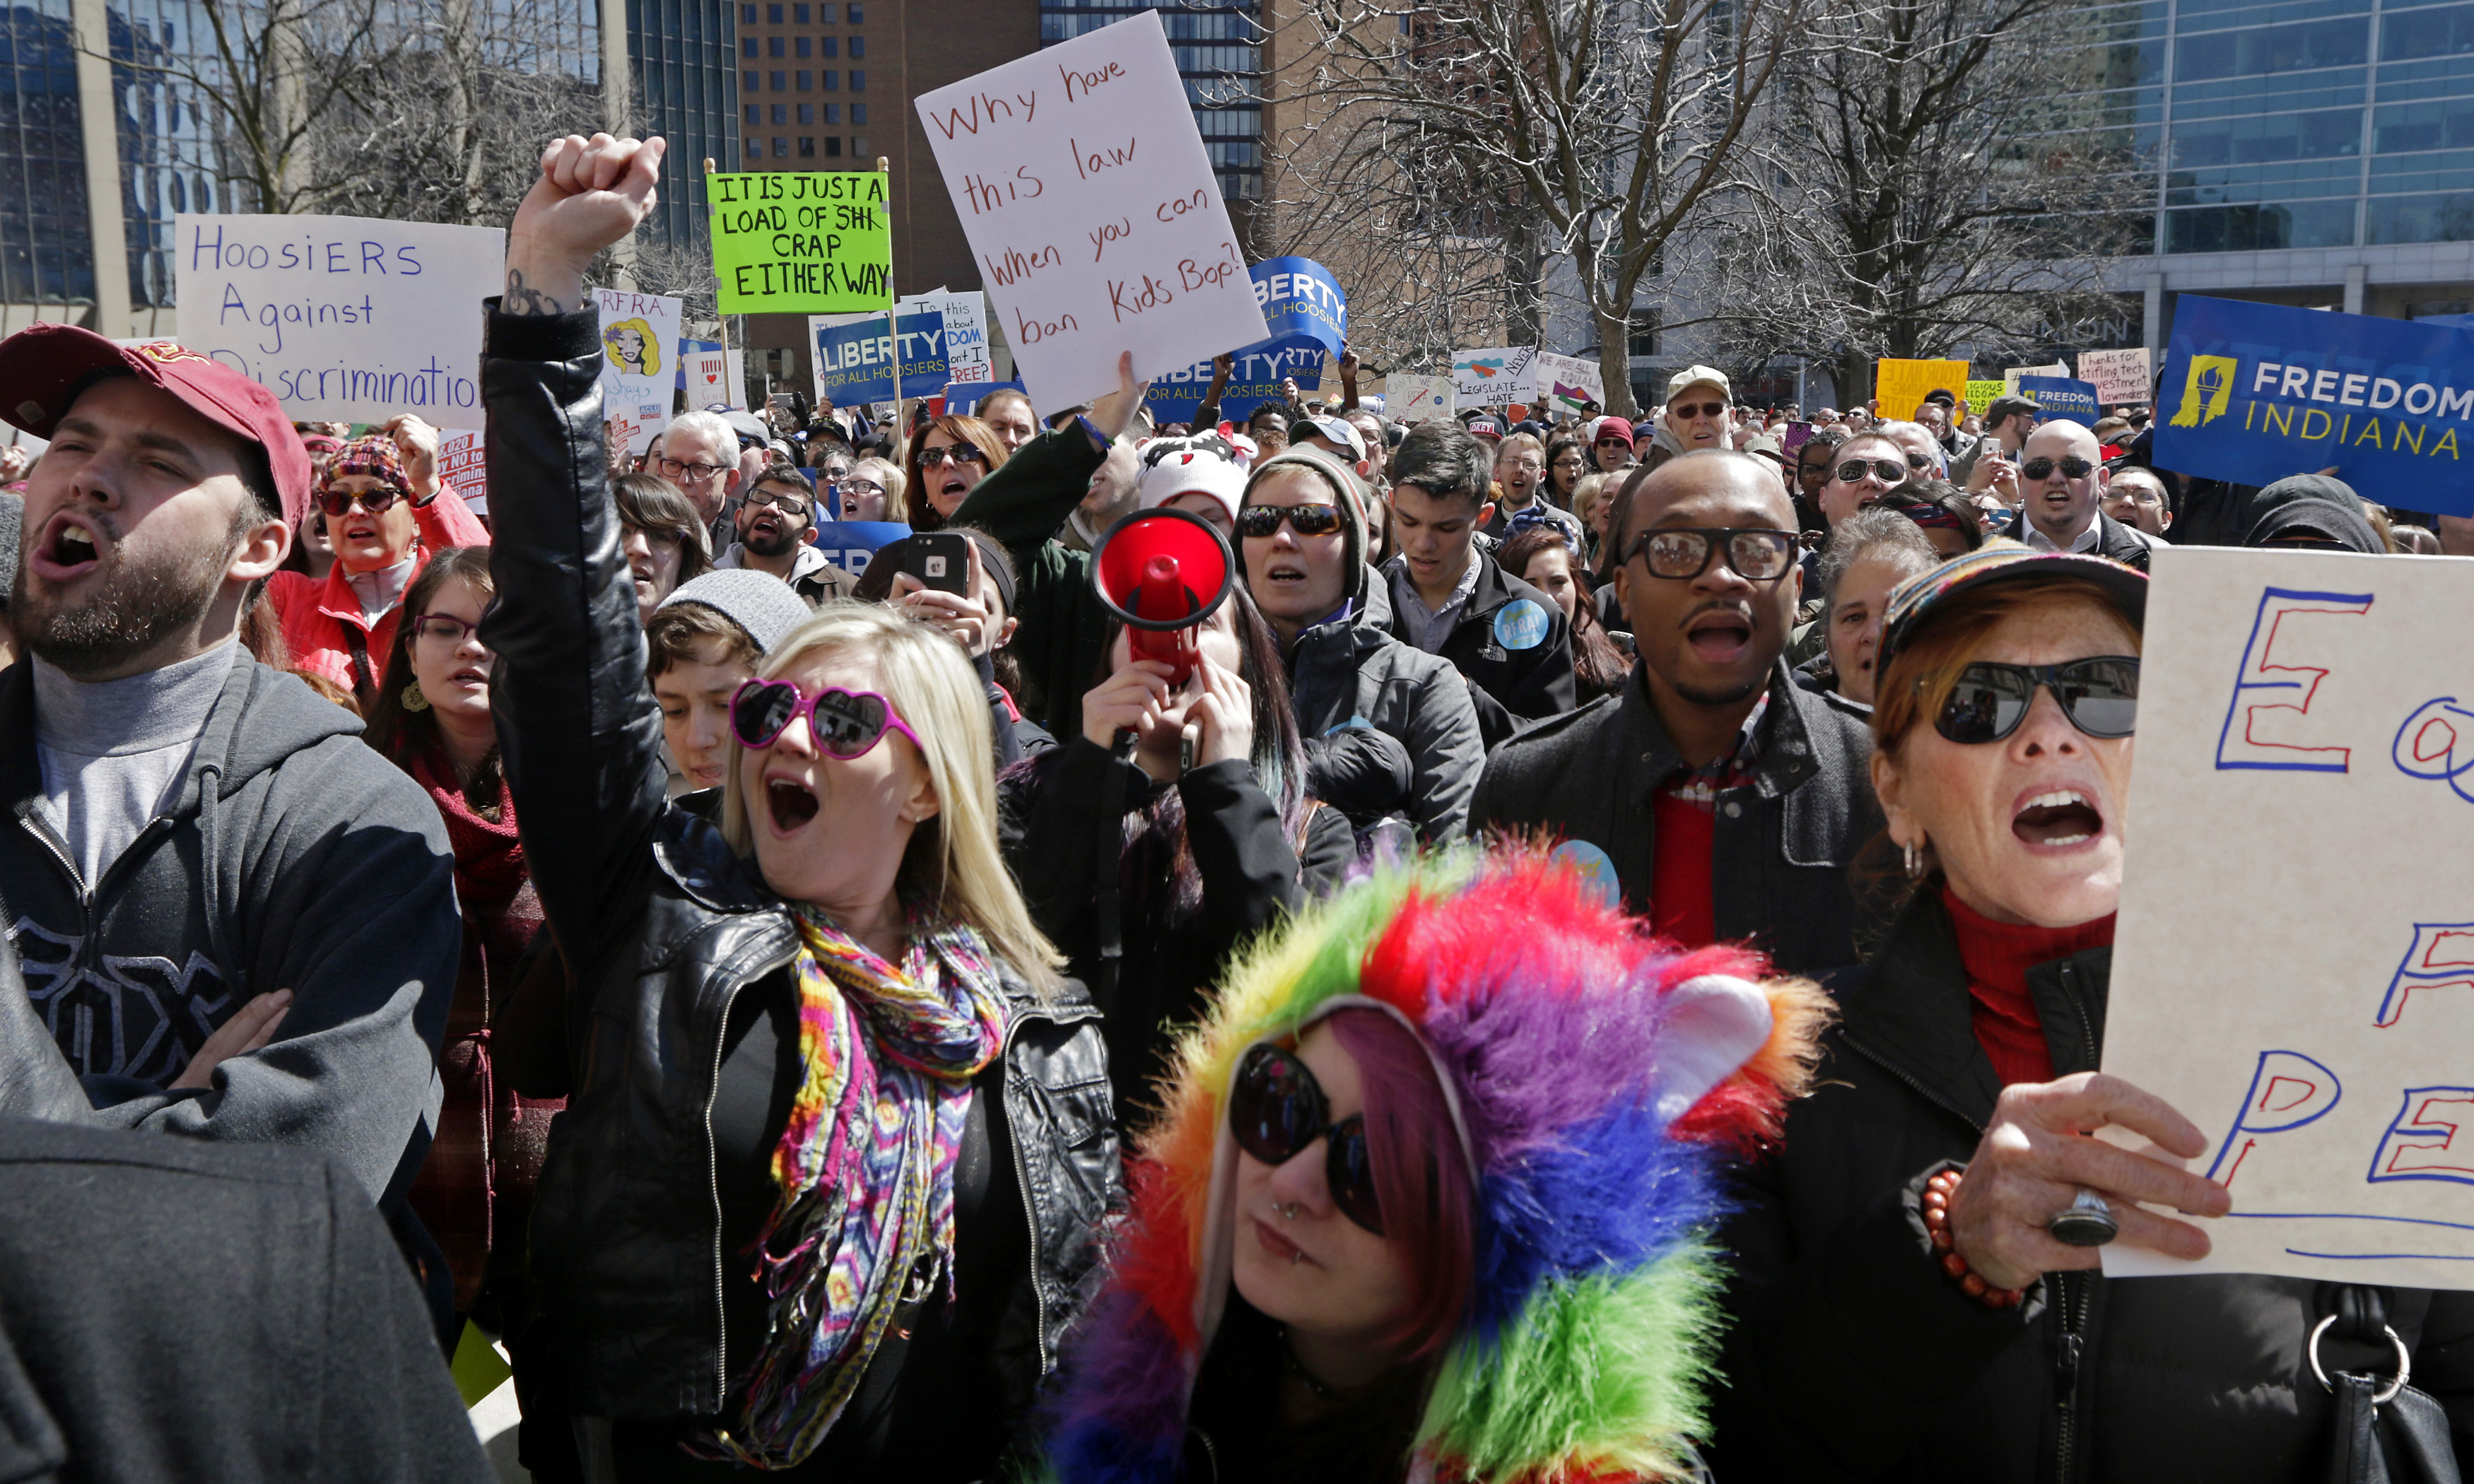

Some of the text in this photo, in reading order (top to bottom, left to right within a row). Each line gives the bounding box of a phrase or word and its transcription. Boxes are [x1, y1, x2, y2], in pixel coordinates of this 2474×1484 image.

[930, 61, 1126, 140] Why have
[963, 137, 1135, 215] this law
[717, 175, 884, 203] IT IS JUST A
[722, 206, 787, 235] LOAD
[798, 206, 827, 229] OF
[1090, 216, 1130, 262] you
[1156, 189, 1208, 223] can
[773, 234, 841, 258] CRAP
[736, 262, 889, 297] EITHER WAY
[1015, 242, 1240, 345] ban Kids Bop?
[1252, 273, 1346, 324] BERTY
[220, 283, 373, 353] Against
[945, 302, 971, 315] this
[946, 317, 974, 329] about
[1283, 301, 1345, 341] HOOSIERS
[944, 328, 985, 347] DOM,
[822, 329, 942, 372] LIBERTY
[949, 346, 983, 364] on't I
[1505, 345, 1535, 375] NEVER
[2080, 351, 2139, 366] Thanks for
[826, 373, 845, 388] FOR
[848, 370, 870, 384] ALL
[873, 359, 946, 379] HOOSIERS
[1540, 354, 1590, 374] WE ARE ALL
[2080, 361, 2146, 380] stifling tech
[210, 349, 484, 408] Discriminatio
[1418, 377, 1434, 387] WE
[1434, 381, 1451, 399] ALL
[2091, 374, 2150, 390] vestment,
[1173, 387, 1202, 400] ALL
[1207, 384, 1284, 399] OOSIERS
[1487, 393, 1516, 405] HATE
[1966, 389, 1998, 398] EEDOM
[2039, 390, 2094, 405] FREEDOM
[2253, 363, 2474, 421] FREEDOM
[640, 405, 660, 413] ACLU
[1388, 406, 1411, 418] JUST
[2039, 401, 2094, 414] INDIANA
[2245, 401, 2459, 460] INDIANA
[451, 452, 468, 469] NO
[471, 451, 483, 463] to
